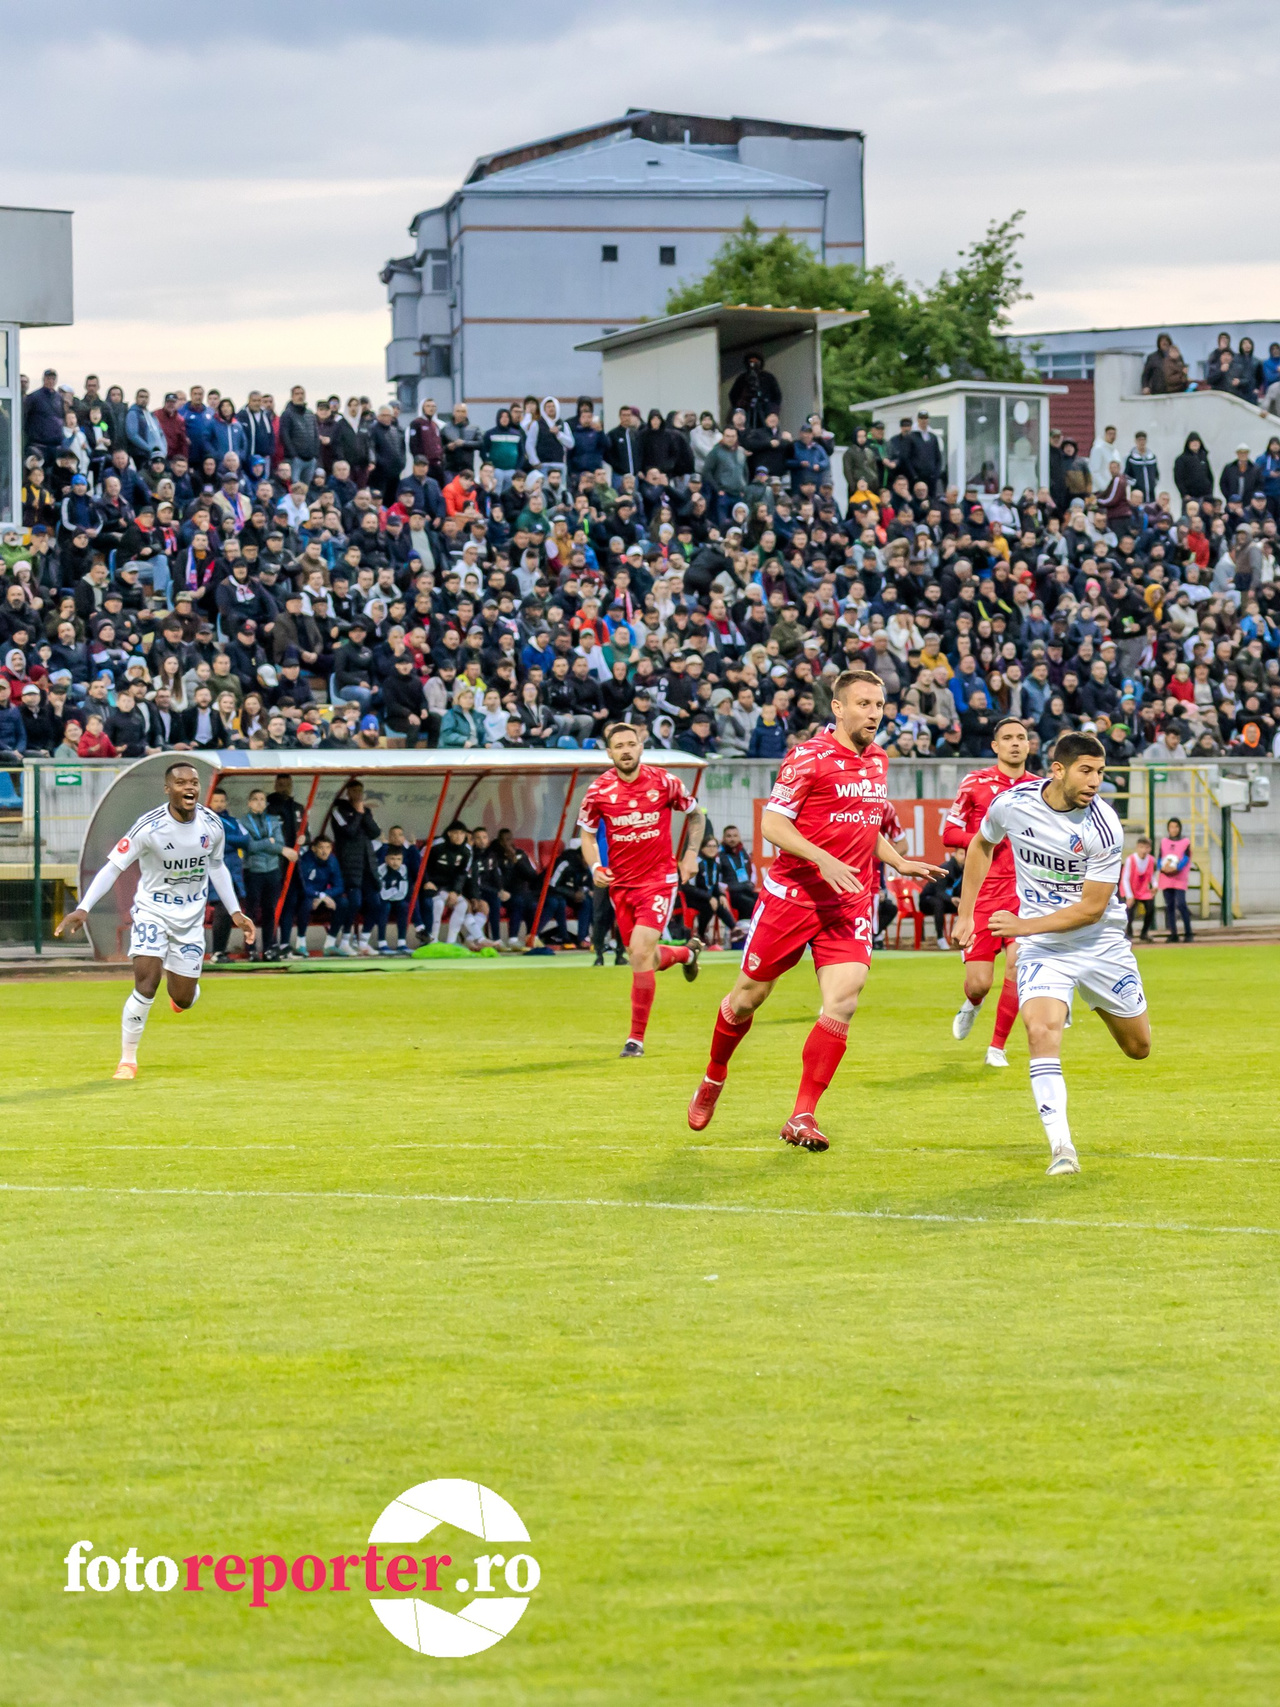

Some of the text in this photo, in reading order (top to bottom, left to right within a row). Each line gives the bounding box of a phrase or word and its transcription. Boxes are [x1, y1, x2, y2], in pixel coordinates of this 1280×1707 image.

[835, 779, 887, 798] WIN2.RO
[611, 811, 660, 827] WIN2.RO
[163, 854, 208, 870] UNIBE
[652, 895, 669, 915] 24
[1019, 962, 1043, 989] 27
